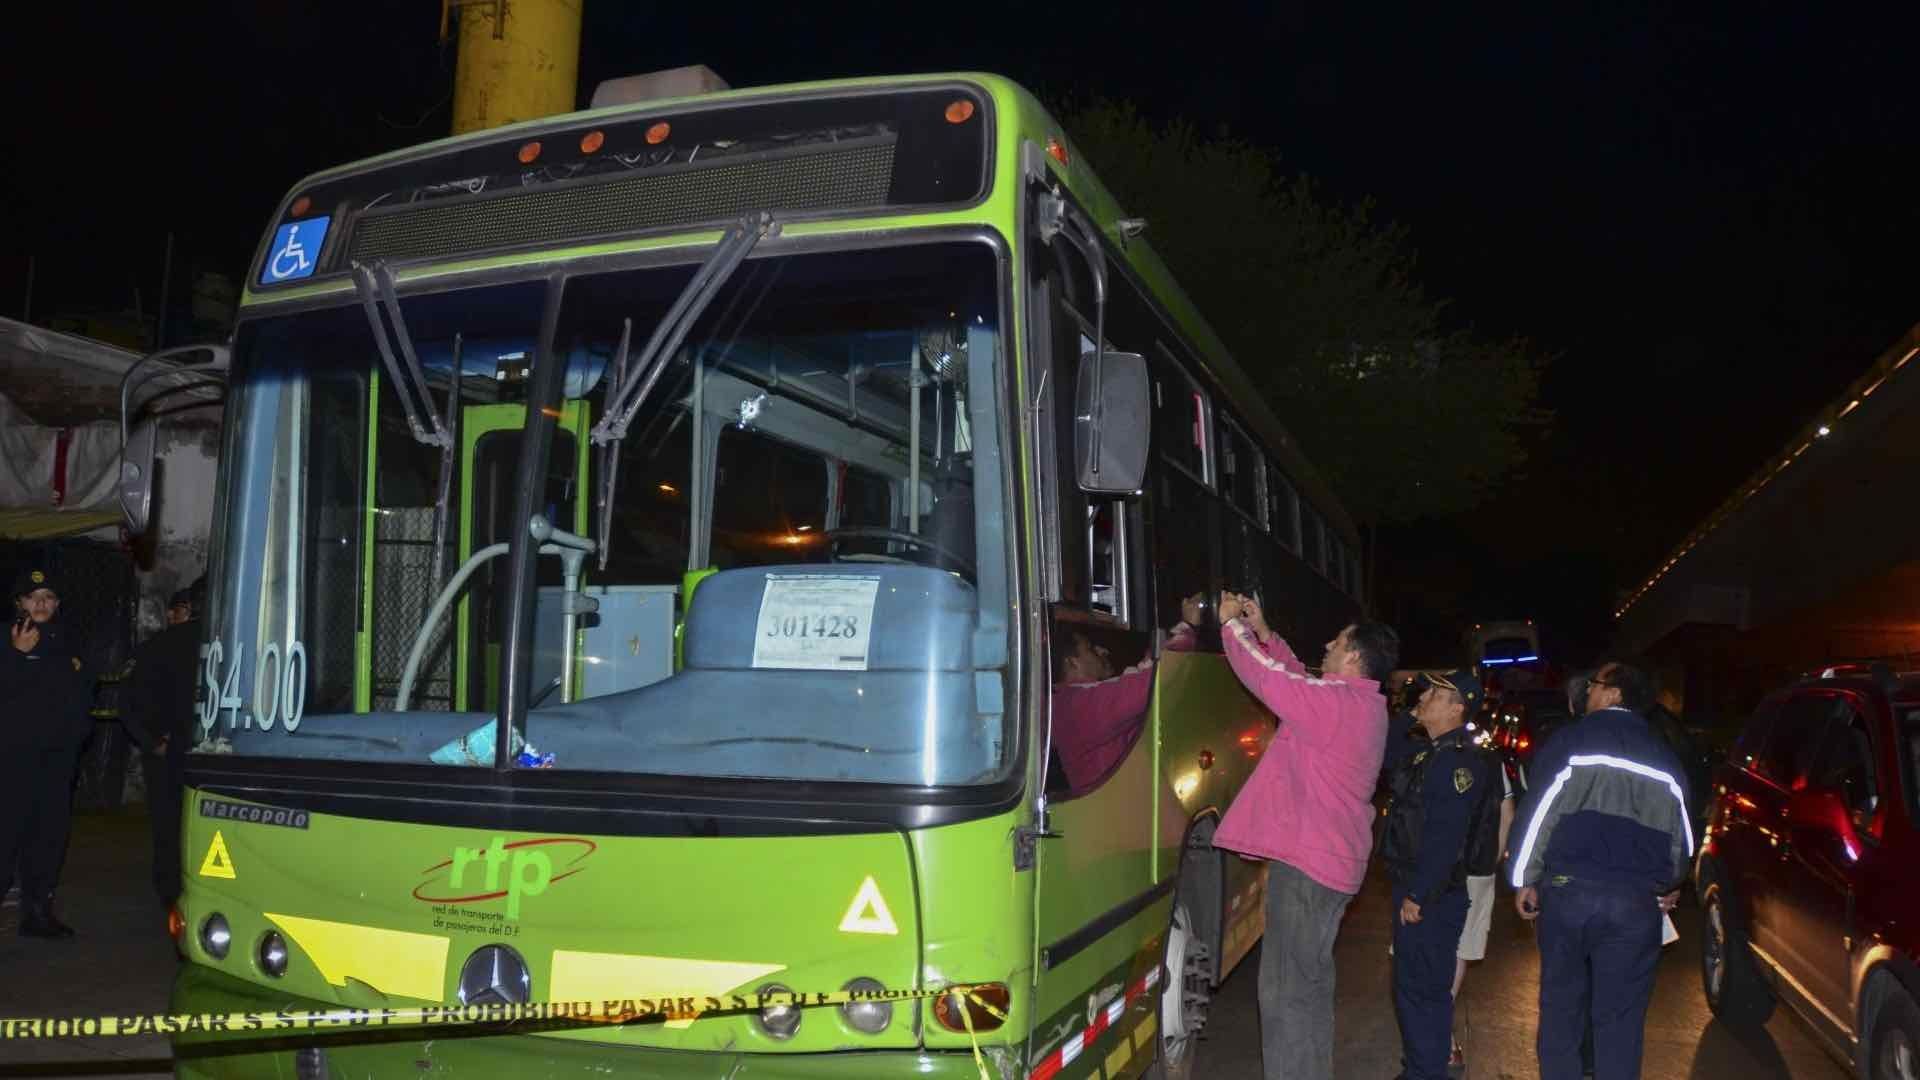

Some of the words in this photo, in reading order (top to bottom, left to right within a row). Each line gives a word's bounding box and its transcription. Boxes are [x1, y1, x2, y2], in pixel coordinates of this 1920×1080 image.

[767, 615, 858, 639] 301428
[200, 635, 307, 739] $4.00
[202, 801, 307, 827] Marcopolo
[449, 837, 552, 920] rtp
[432, 904, 446, 914] red
[433, 917, 445, 928] de
[118, 1013, 229, 1035] PASAR
[420, 1000, 592, 1025] PROHIBIDO
[602, 997, 695, 1018] PASAR
